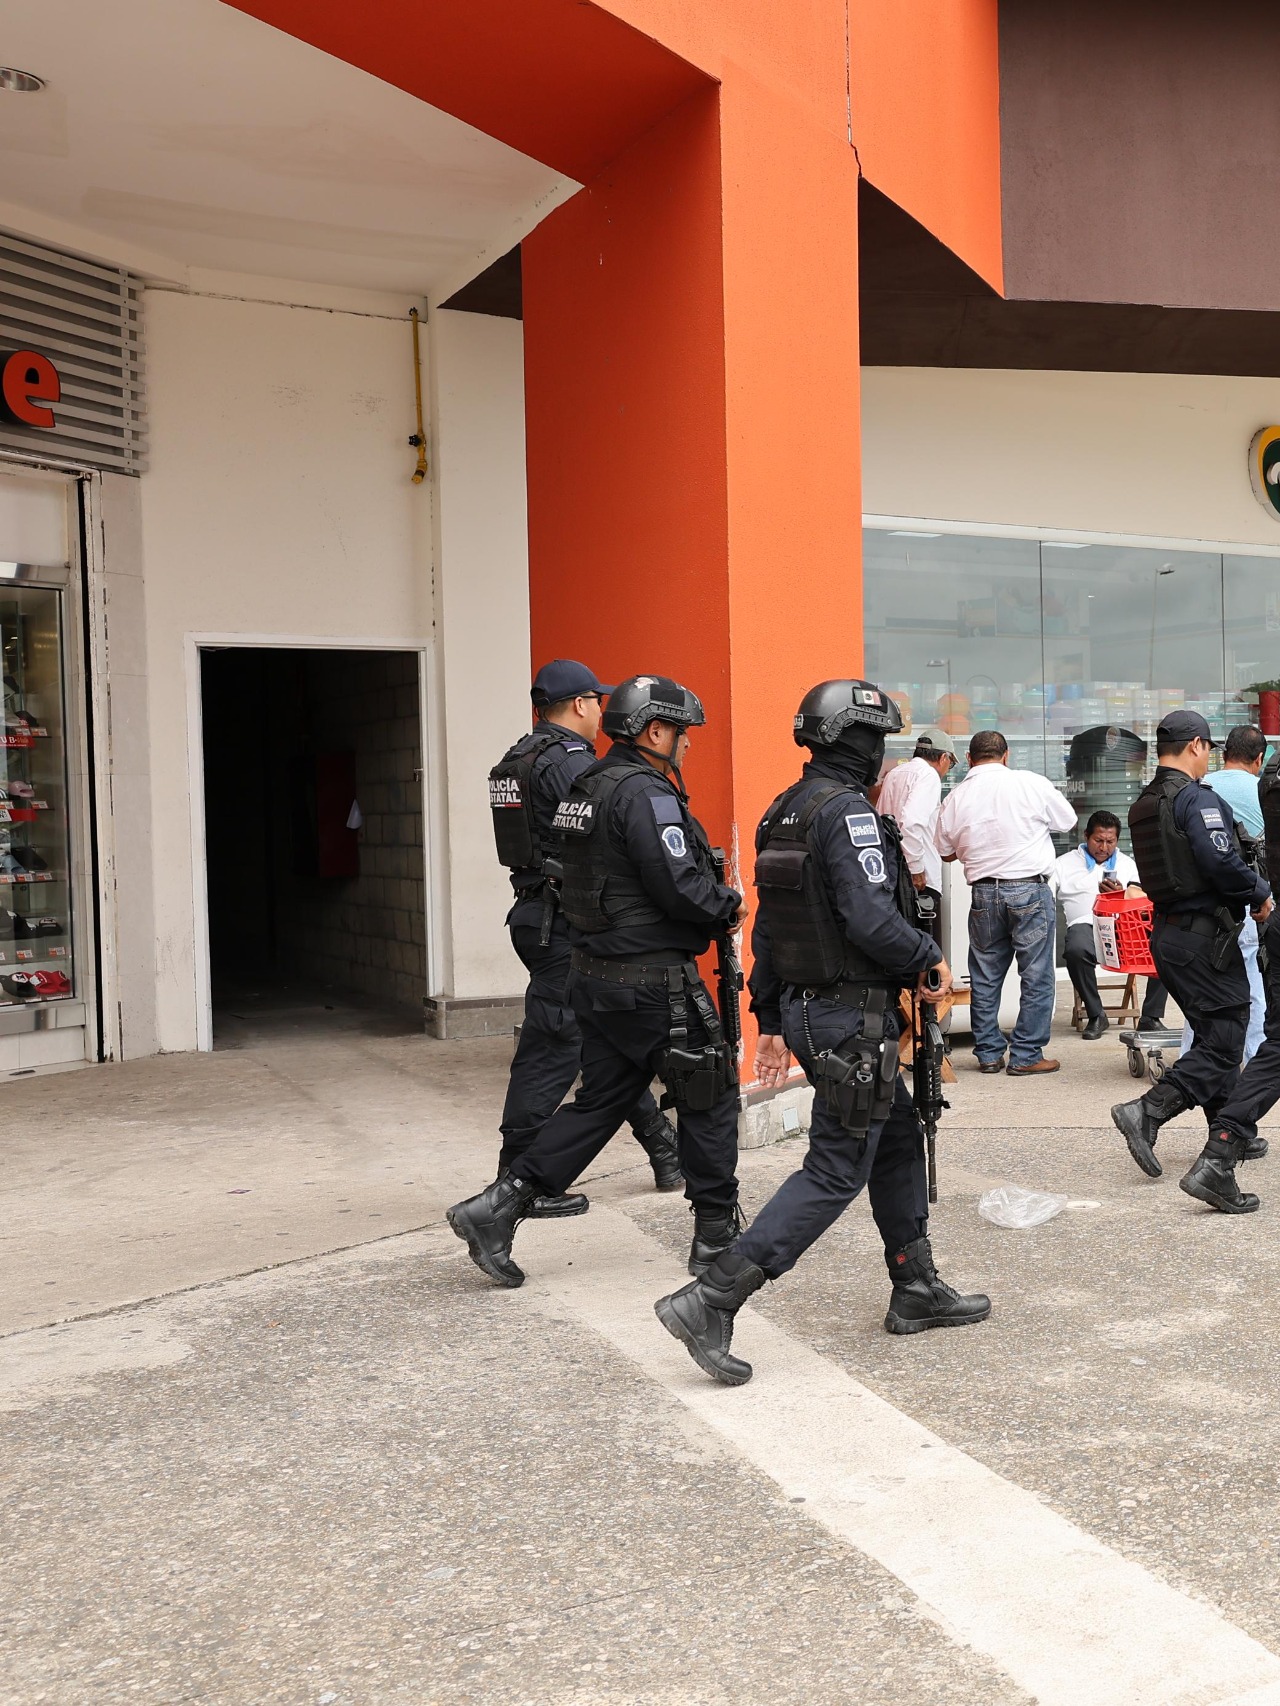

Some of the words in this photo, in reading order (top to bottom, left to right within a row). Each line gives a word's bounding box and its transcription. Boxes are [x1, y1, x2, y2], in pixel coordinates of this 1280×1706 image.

[489, 778, 520, 791] OLICÍA
[489, 793, 522, 804] STATAL
[556, 801, 593, 818] OLICÍA
[551, 814, 585, 831] STATAL
